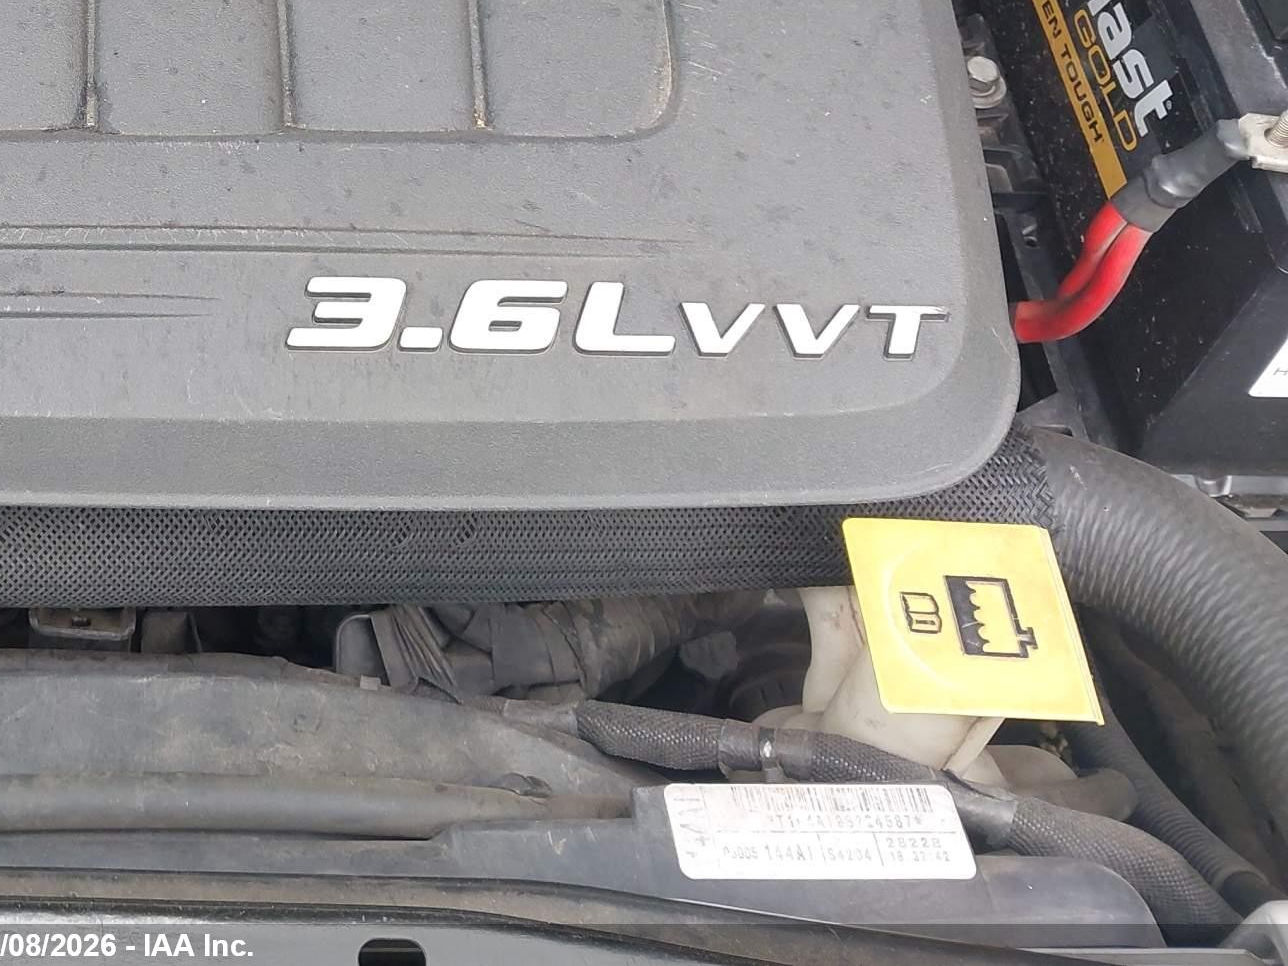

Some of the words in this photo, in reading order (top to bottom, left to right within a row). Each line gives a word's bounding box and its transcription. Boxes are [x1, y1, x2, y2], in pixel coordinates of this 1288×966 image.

[1059, 43, 1103, 141] TOUGH
[1073, 9, 1137, 152] GOLD
[286, 276, 676, 358] 3.6L
[678, 301, 950, 360] VVT
